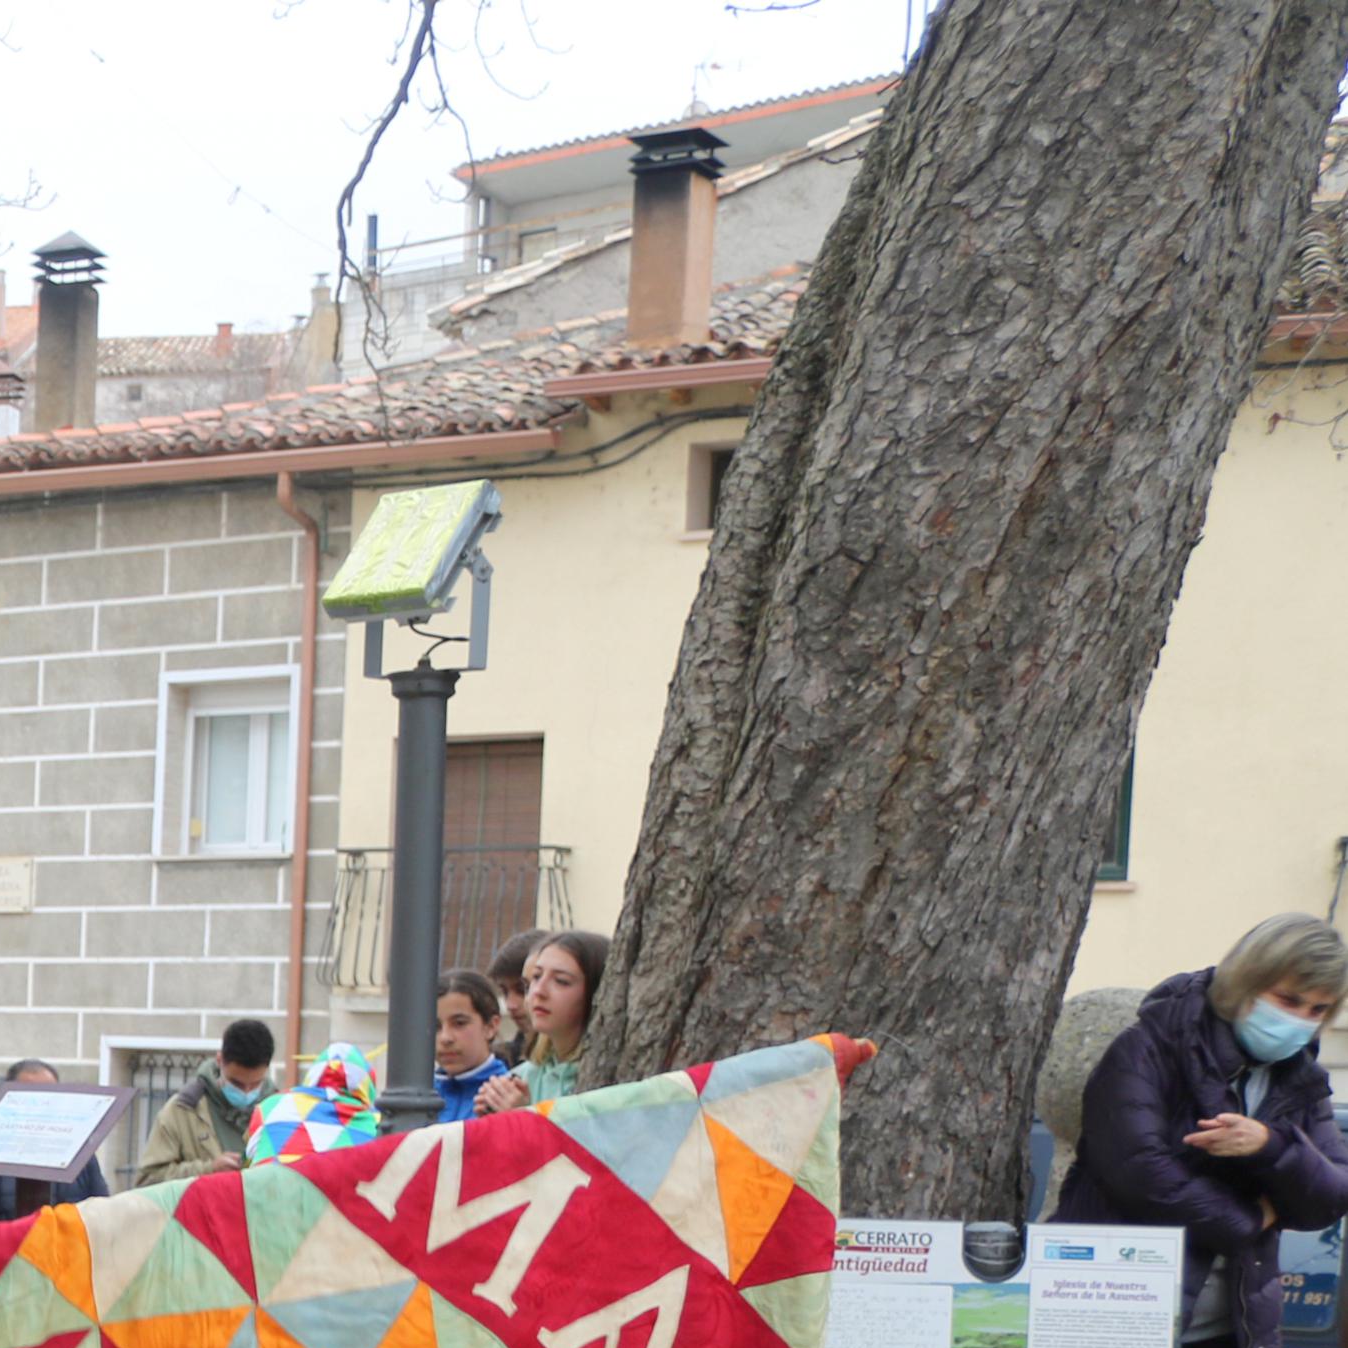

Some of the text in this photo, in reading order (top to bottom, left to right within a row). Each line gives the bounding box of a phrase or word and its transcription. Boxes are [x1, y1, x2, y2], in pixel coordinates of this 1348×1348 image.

[855, 1231, 933, 1247] CERRATO
[834, 1256, 929, 1276] ntigüedad
[1053, 1280, 1148, 1292] Iglesia de Nuestra
[1041, 1289, 1159, 1302] Señora de la Asunción
